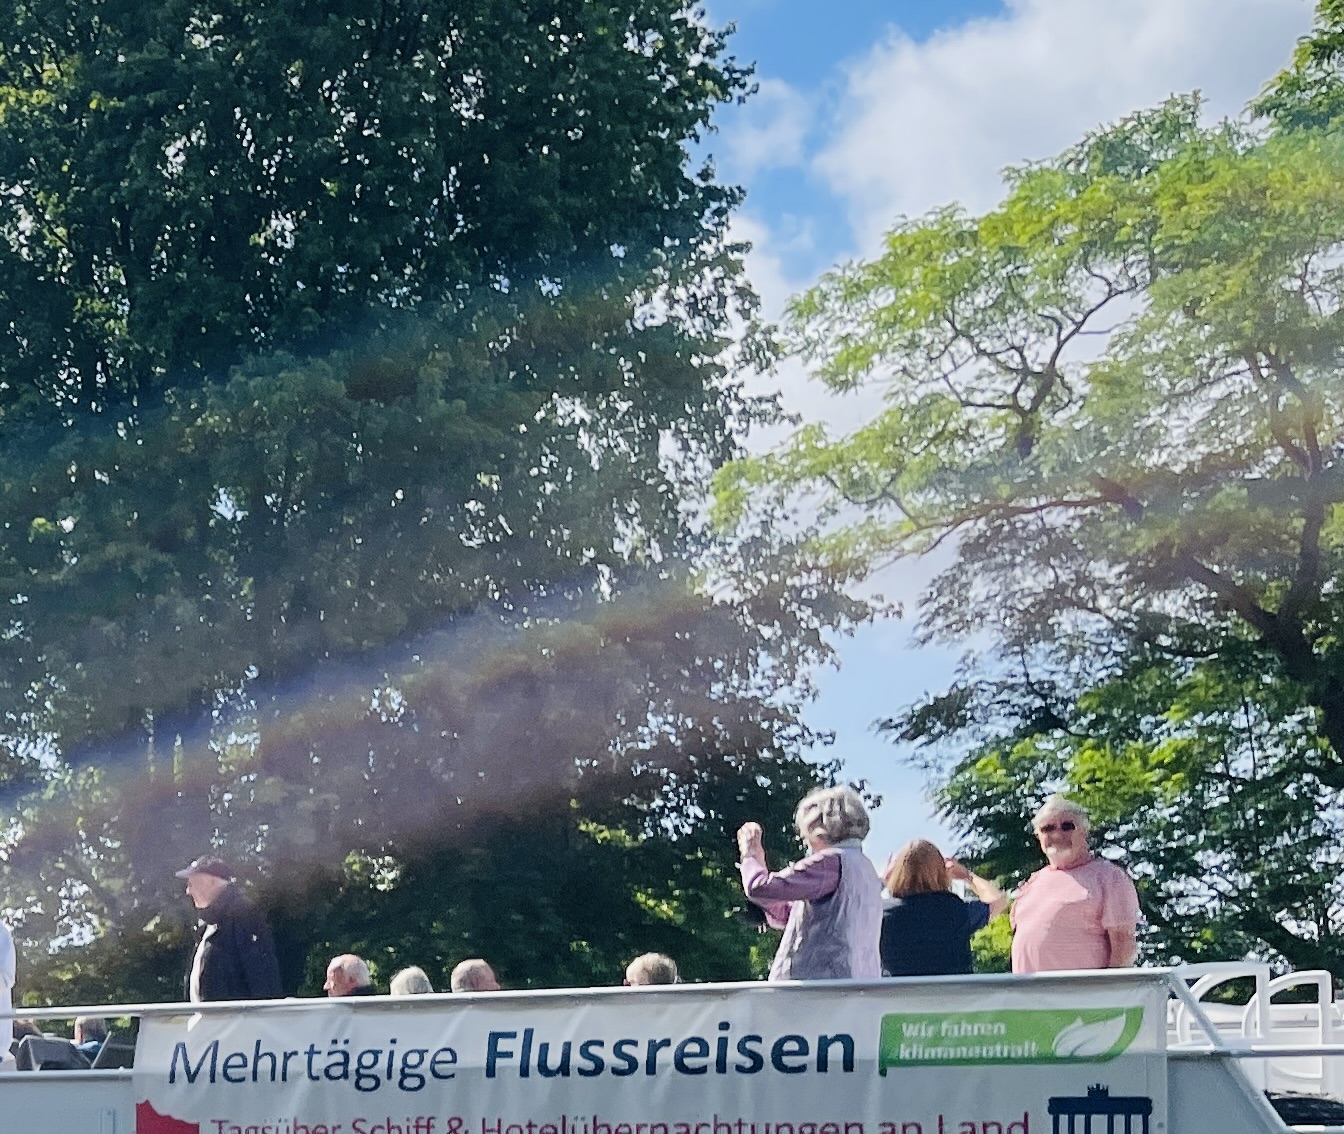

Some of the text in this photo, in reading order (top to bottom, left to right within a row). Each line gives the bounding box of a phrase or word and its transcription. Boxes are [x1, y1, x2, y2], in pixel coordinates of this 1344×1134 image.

[901, 1020, 1007, 1037] Wir fahren
[168, 1020, 856, 1092] Mehrtägige Flussreisen
